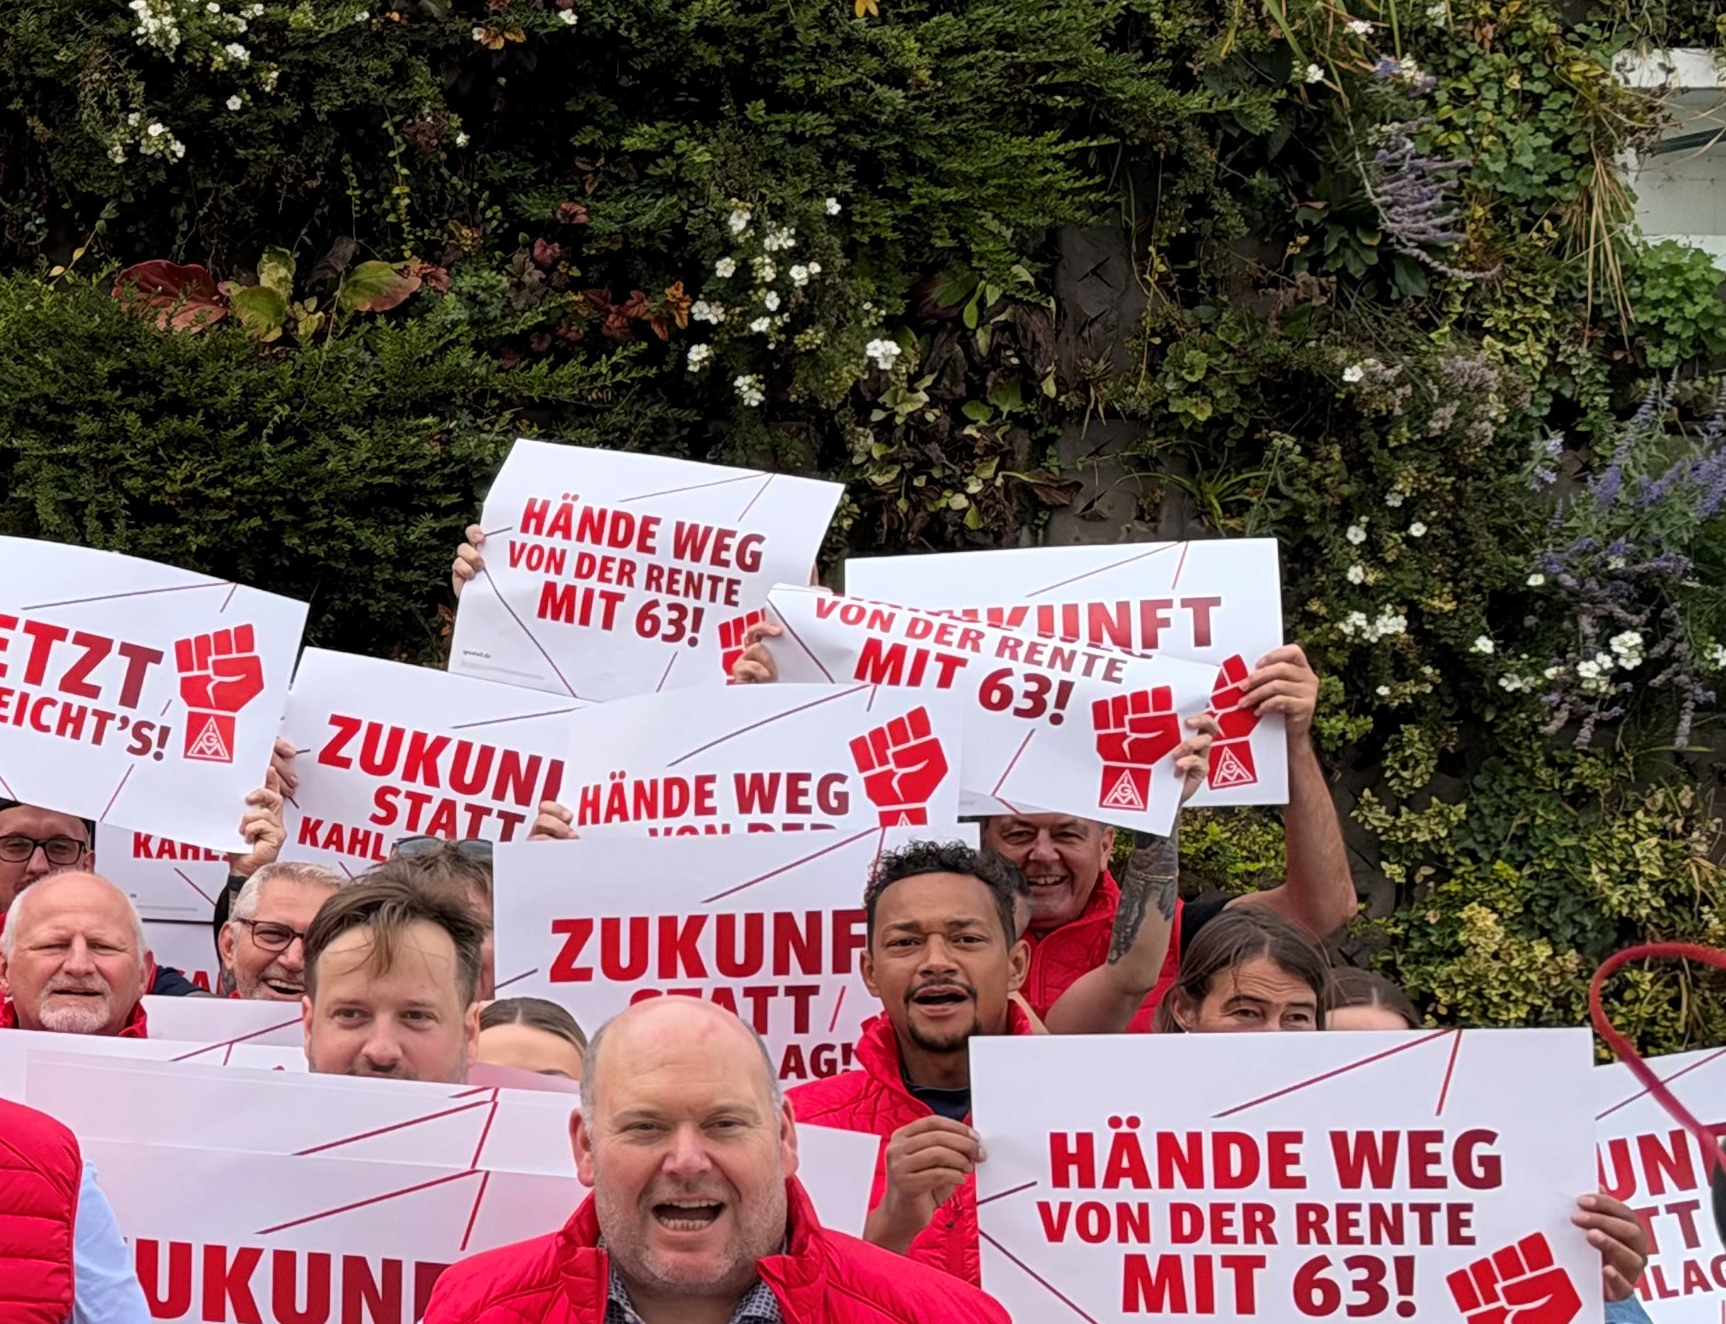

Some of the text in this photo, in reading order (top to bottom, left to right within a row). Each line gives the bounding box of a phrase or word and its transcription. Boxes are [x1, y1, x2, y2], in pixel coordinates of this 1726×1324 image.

[521, 493, 759, 571] HÄNDE WEG
[510, 542, 737, 605] VON DER RENTE
[538, 582, 702, 644] MIT 63!
[818, 600, 1128, 684] VON DER RENTE
[943, 596, 1221, 652] KUNFT
[855, 639, 1071, 724] MIT 63!
[319, 715, 563, 806] ZUKUN
[370, 786, 524, 841] STATT
[579, 773, 847, 825] HÄNDE WEG
[549, 909, 867, 983] ZUKUNF
[1050, 1116, 1501, 1189] HÄNDE WEG
[1038, 1202, 1474, 1245] VON DER RENTE
[1123, 1254, 1415, 1317] MIT 63!
